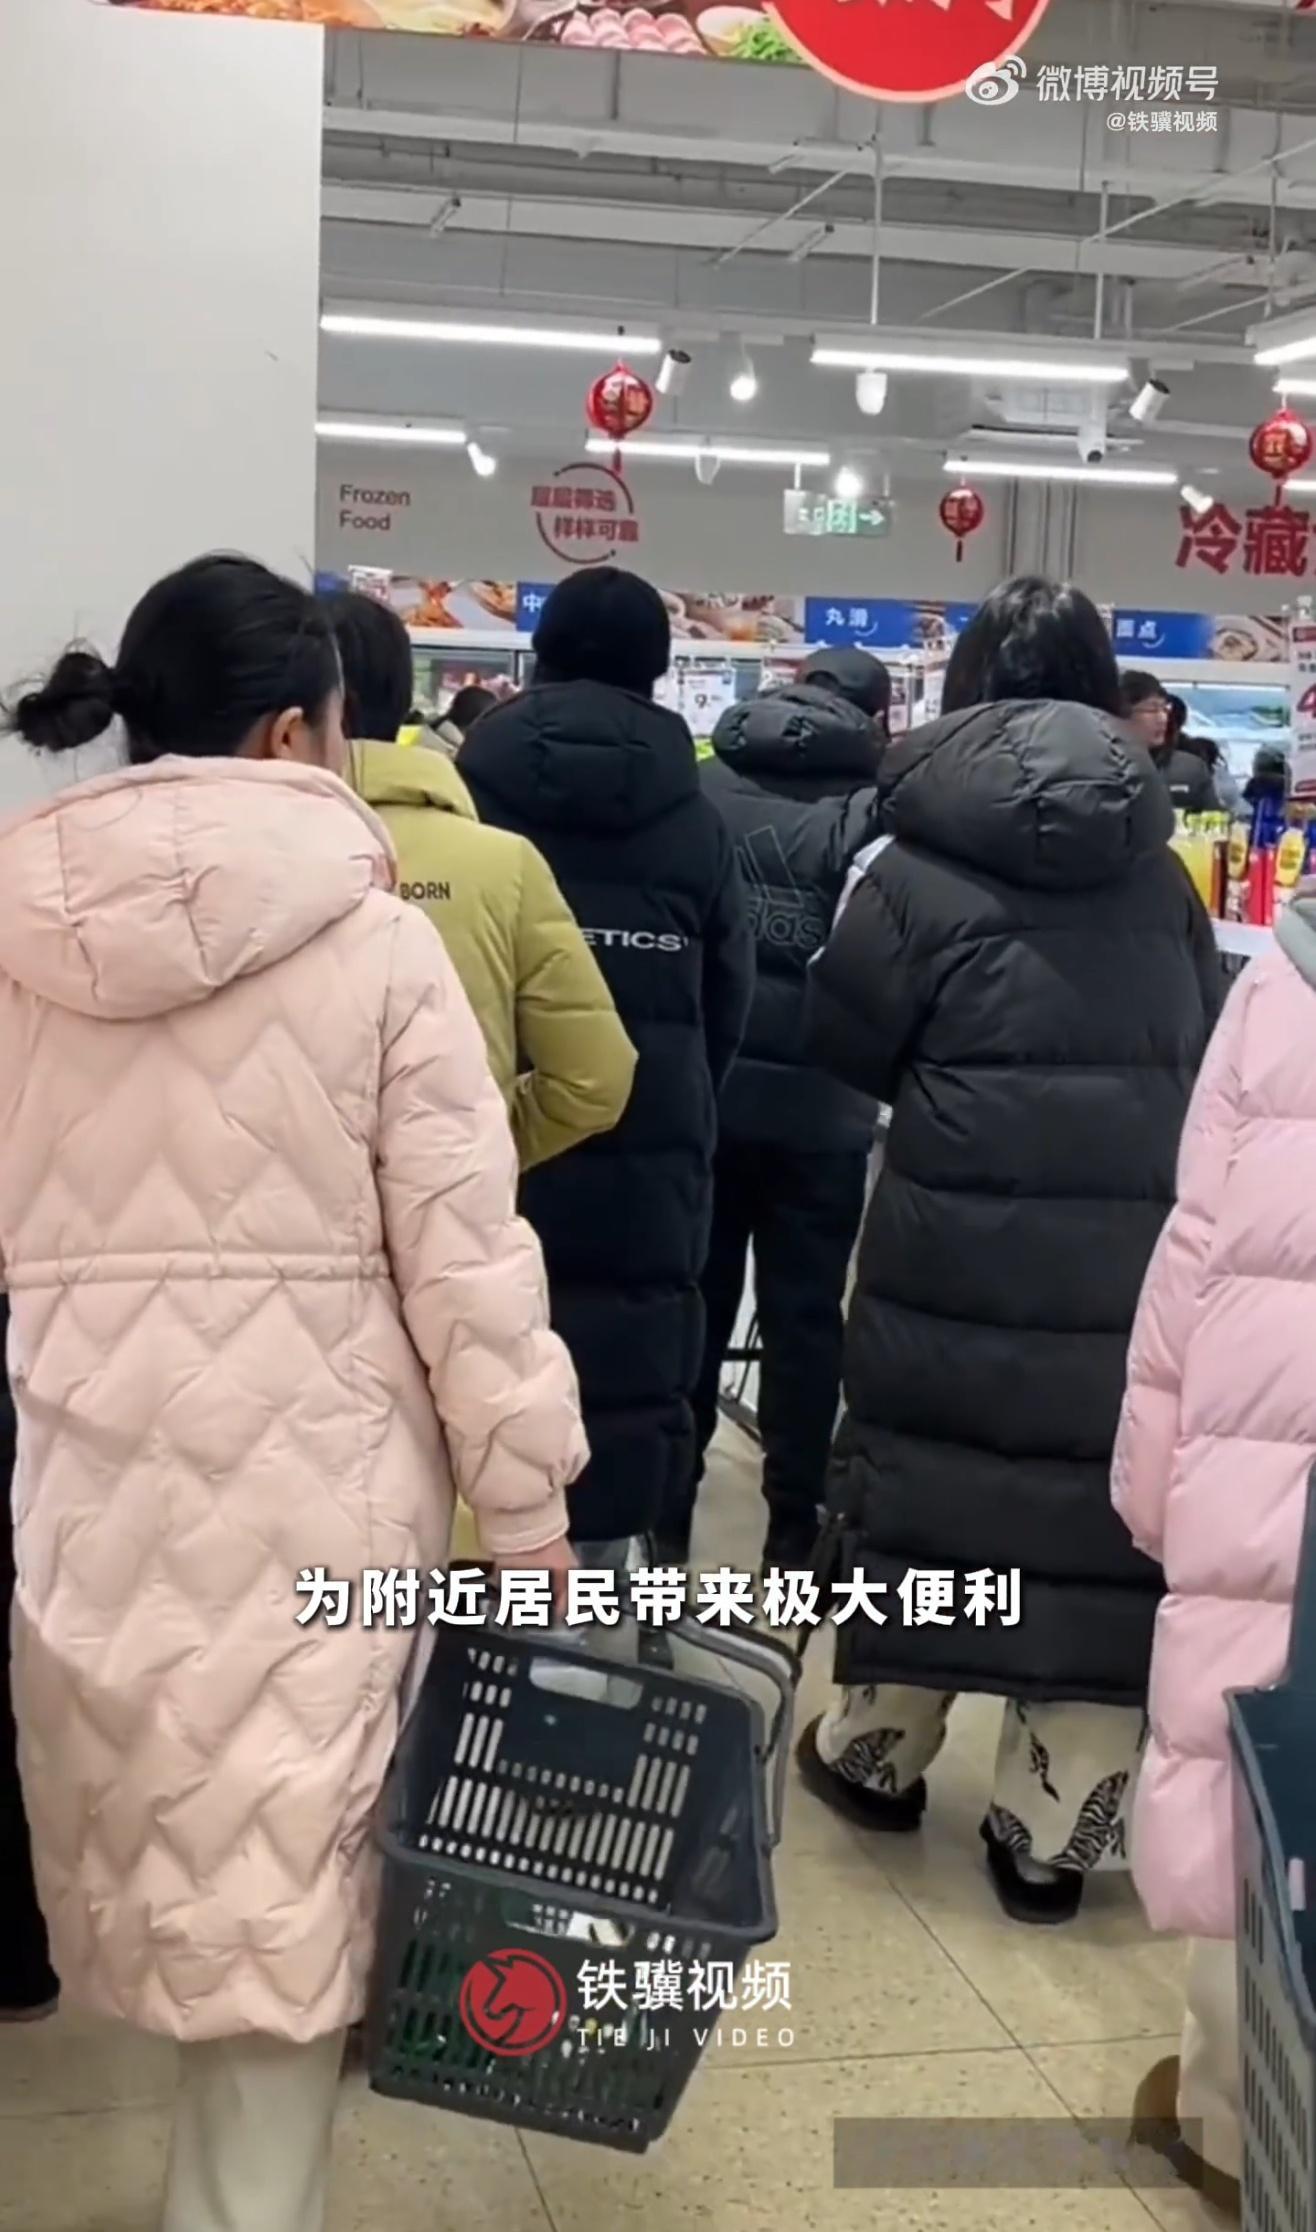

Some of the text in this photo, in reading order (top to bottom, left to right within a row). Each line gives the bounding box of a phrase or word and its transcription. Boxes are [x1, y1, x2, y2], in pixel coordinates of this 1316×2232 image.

[340, 484, 411, 506] Frozen
[340, 510, 391, 530] Food
[1175, 502, 1316, 577] 冷藏
[400, 881, 451, 901] BORN
